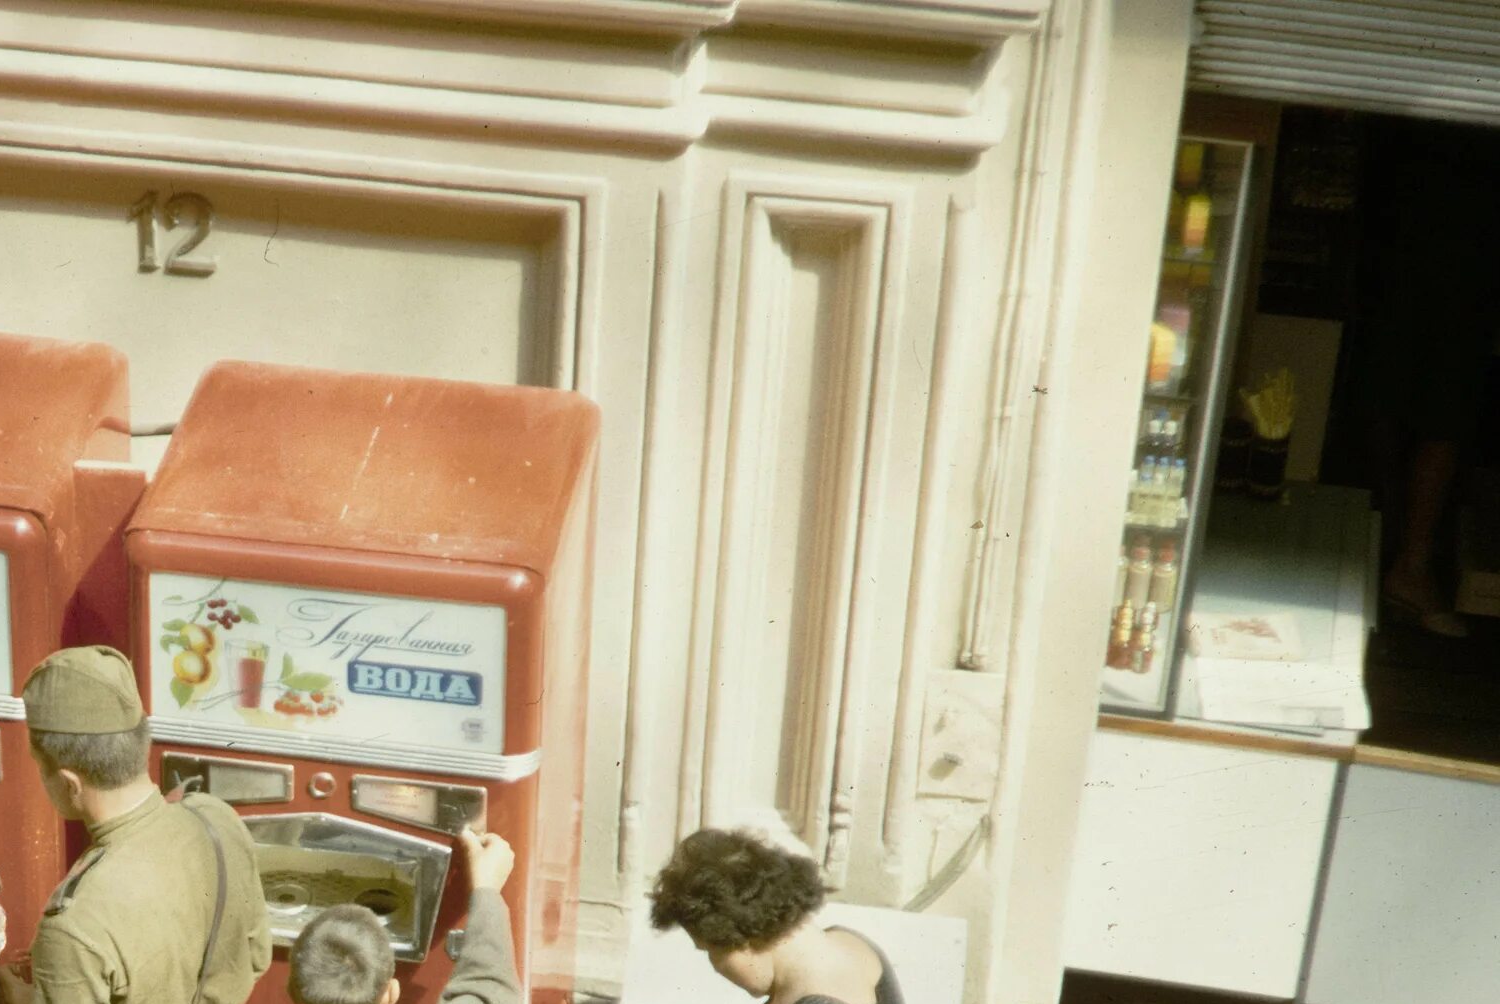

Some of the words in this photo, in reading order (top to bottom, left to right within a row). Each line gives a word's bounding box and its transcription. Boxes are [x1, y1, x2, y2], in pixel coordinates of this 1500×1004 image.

[127, 190, 217, 279] 12
[276, 597, 476, 660] Газированная
[354, 663, 477, 701] ВОДА
